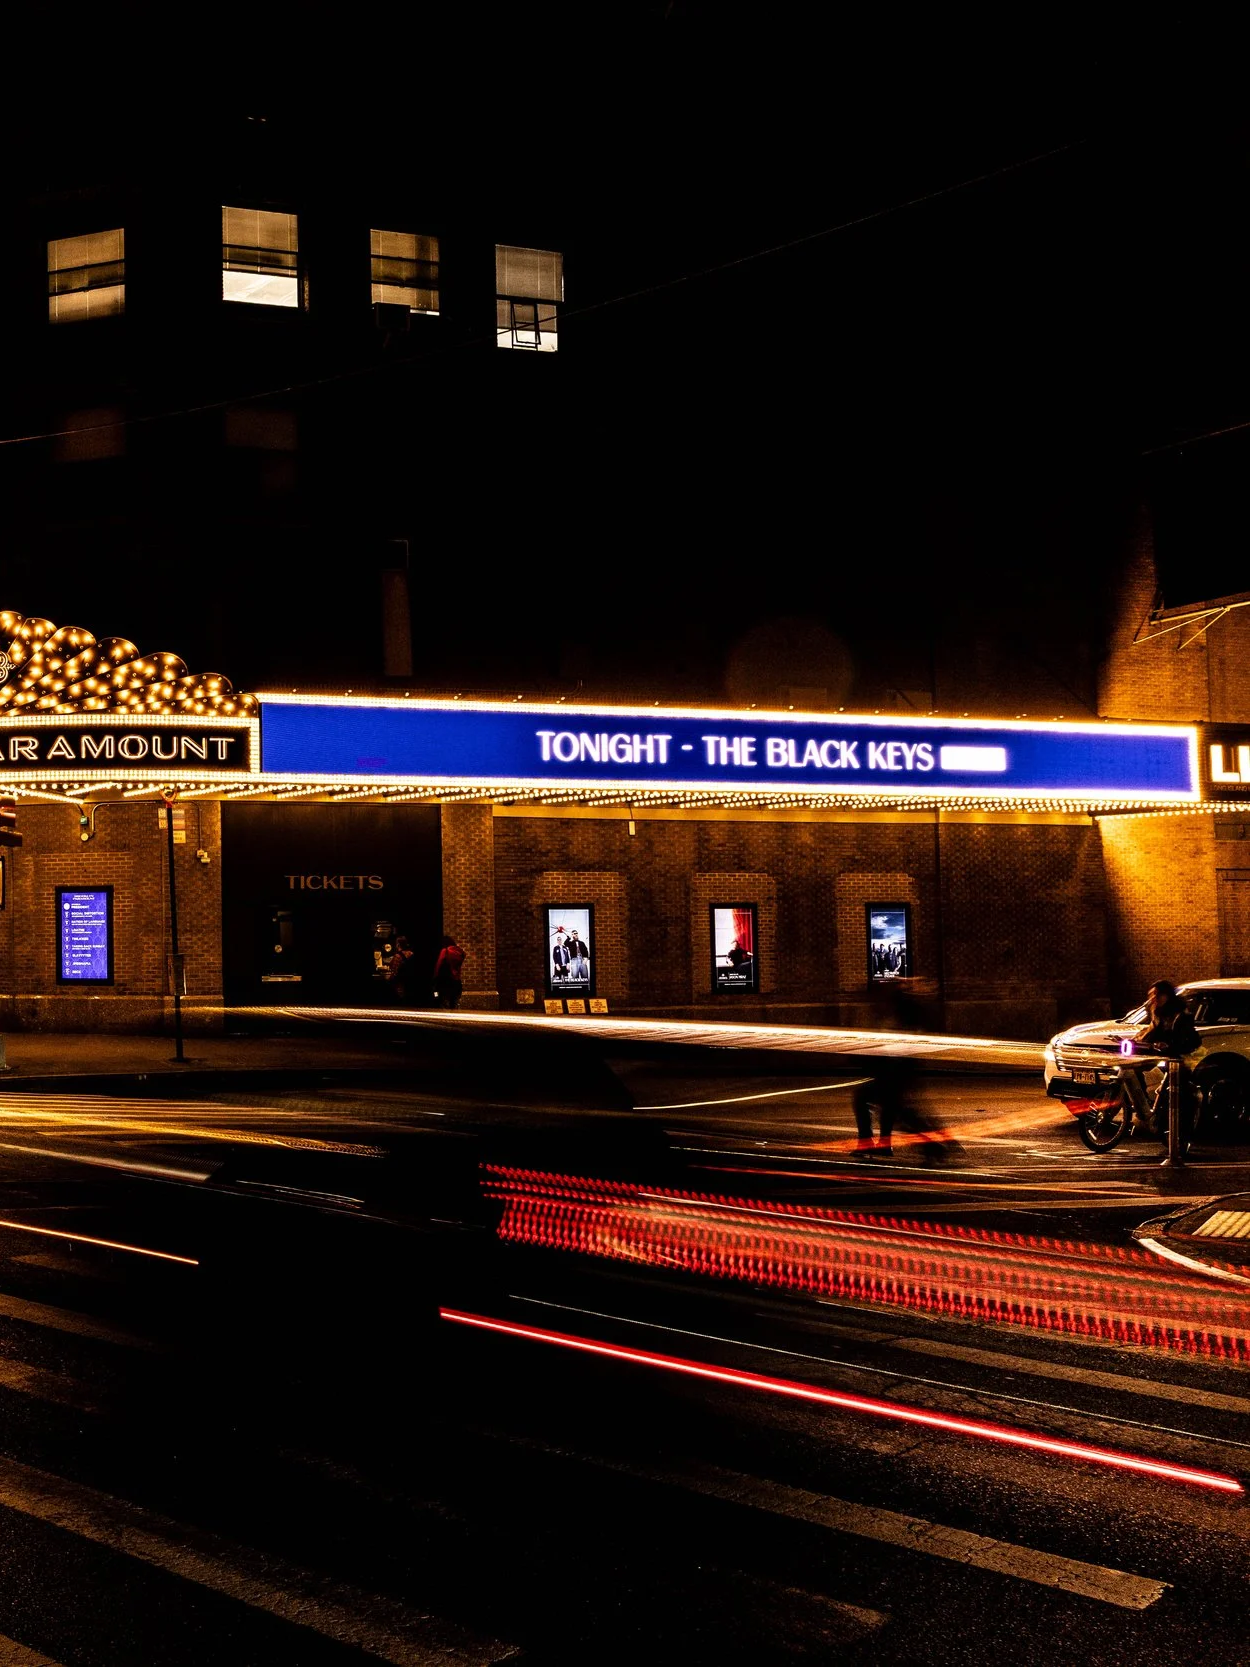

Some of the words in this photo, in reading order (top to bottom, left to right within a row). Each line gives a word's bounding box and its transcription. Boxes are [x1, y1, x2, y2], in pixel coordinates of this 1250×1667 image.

[536, 731, 672, 764] TONIGHT
[701, 736, 758, 766] THE
[766, 737, 860, 769] BLACK
[868, 741, 935, 771] KEYS
[284, 875, 384, 890] TICKETS
